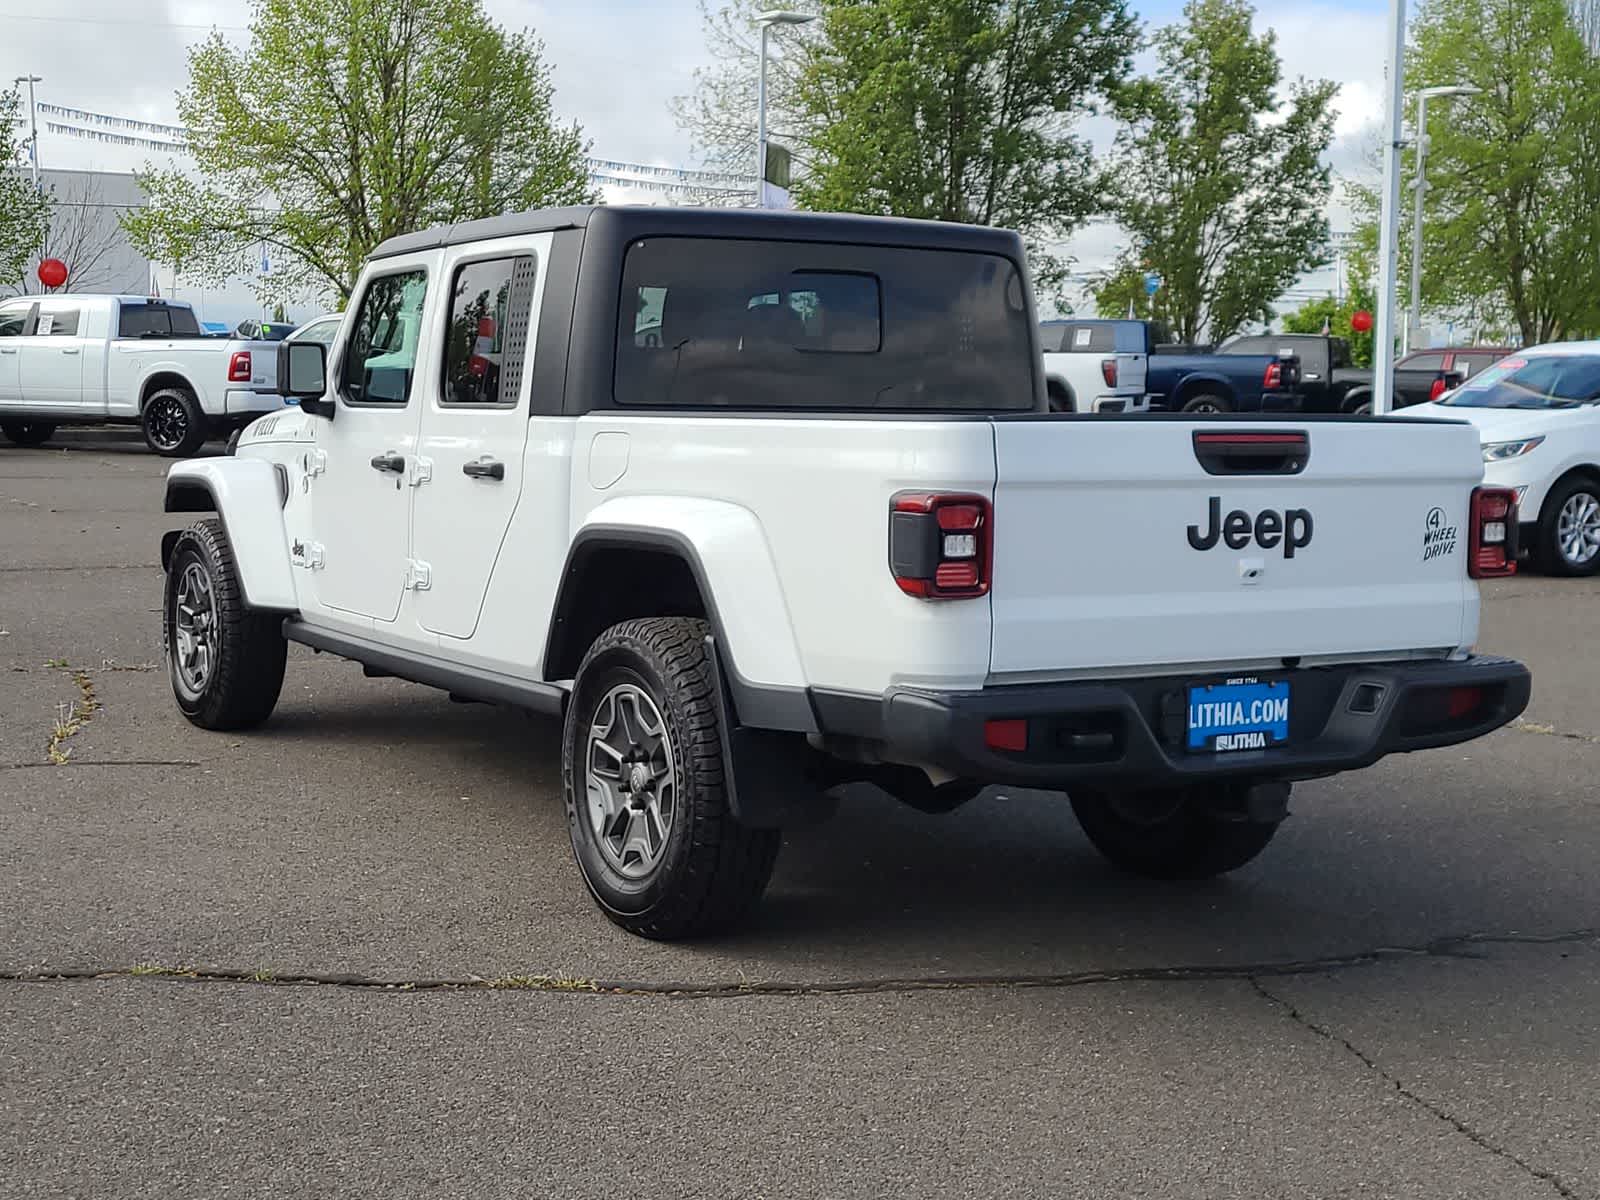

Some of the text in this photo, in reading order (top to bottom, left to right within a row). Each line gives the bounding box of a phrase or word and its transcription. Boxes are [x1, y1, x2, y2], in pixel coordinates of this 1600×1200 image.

[1187, 496, 1313, 559] Jeep
[1430, 511, 1440, 528] 4
[1424, 527, 1457, 545] WHEEL
[1424, 541, 1457, 560] DRIVE
[1189, 698, 1289, 729] LITHIA.COM
[1228, 732, 1266, 749] LITHIA
